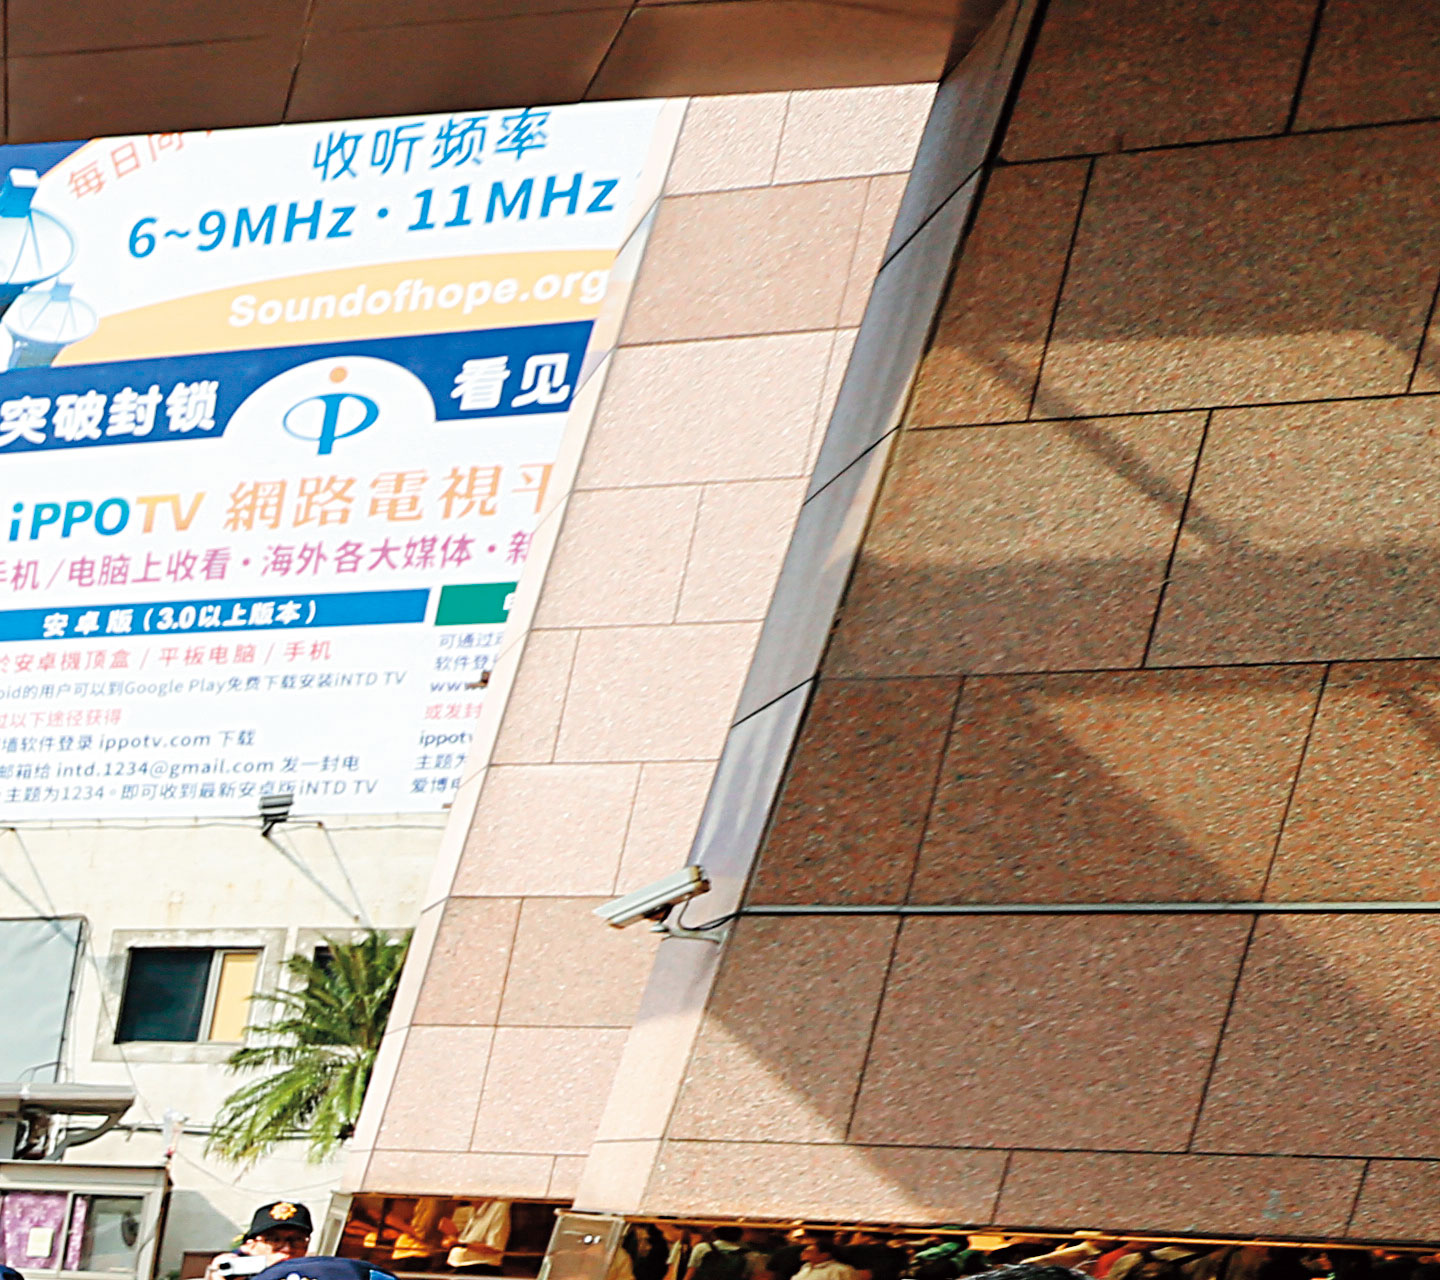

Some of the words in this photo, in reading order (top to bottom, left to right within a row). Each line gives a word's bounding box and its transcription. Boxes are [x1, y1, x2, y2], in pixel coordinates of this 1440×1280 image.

[312, 107, 552, 184] 收听频率
[227, 265, 611, 329] Soundofhope.org
[449, 354, 572, 411] 看见
[99, 735, 211, 752] ippotv.com
[218, 728, 257, 747] 下载
